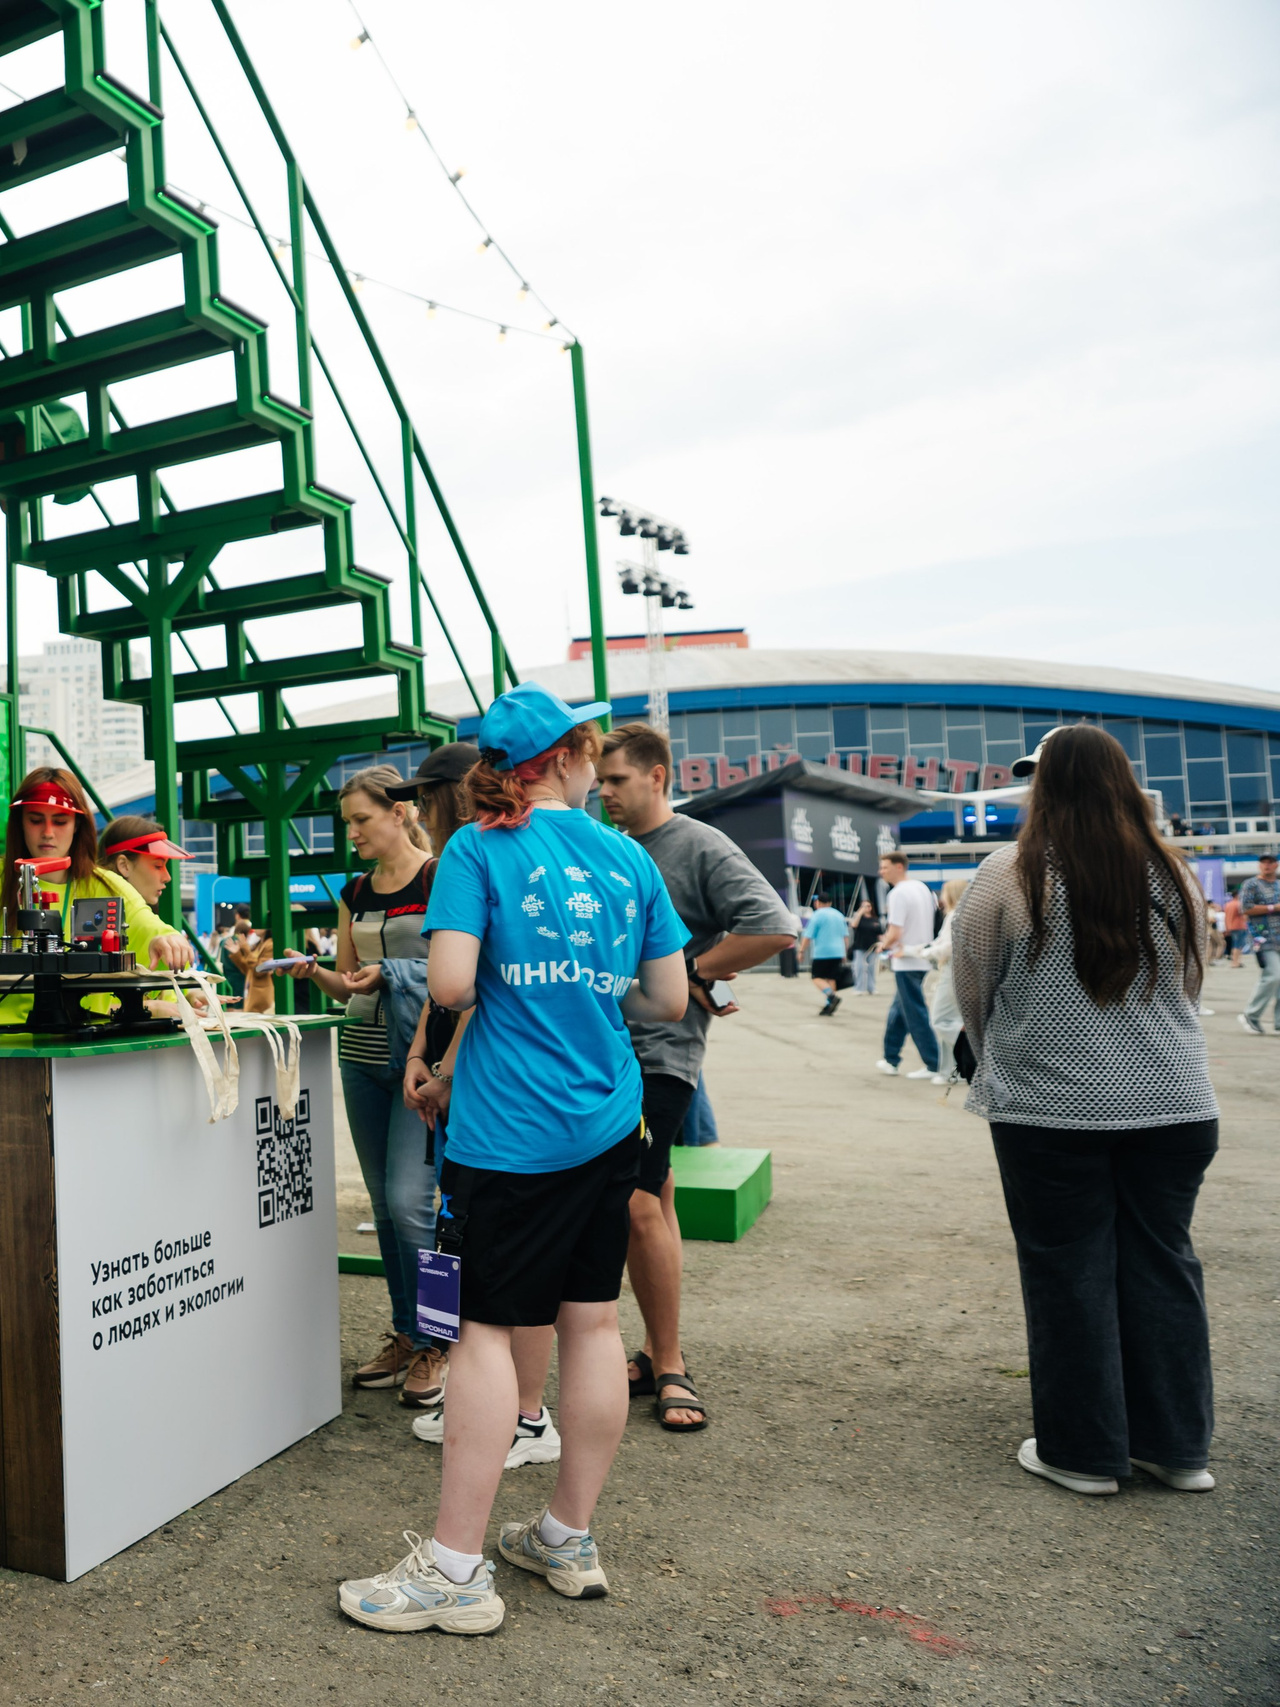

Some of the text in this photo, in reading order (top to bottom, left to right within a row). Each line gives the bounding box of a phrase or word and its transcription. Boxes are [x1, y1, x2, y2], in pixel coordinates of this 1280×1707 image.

[673, 743, 802, 792] ВЫЙ
[521, 899, 545, 912] fest
[565, 897, 602, 913] fest
[573, 892, 593, 902] VK
[91, 1230, 212, 1286] Узнать больше
[92, 1258, 214, 1319] как заботиться
[92, 1276, 245, 1350] о людях и экологии
[419, 1321, 453, 1336] ПЕРСОНАЛ
